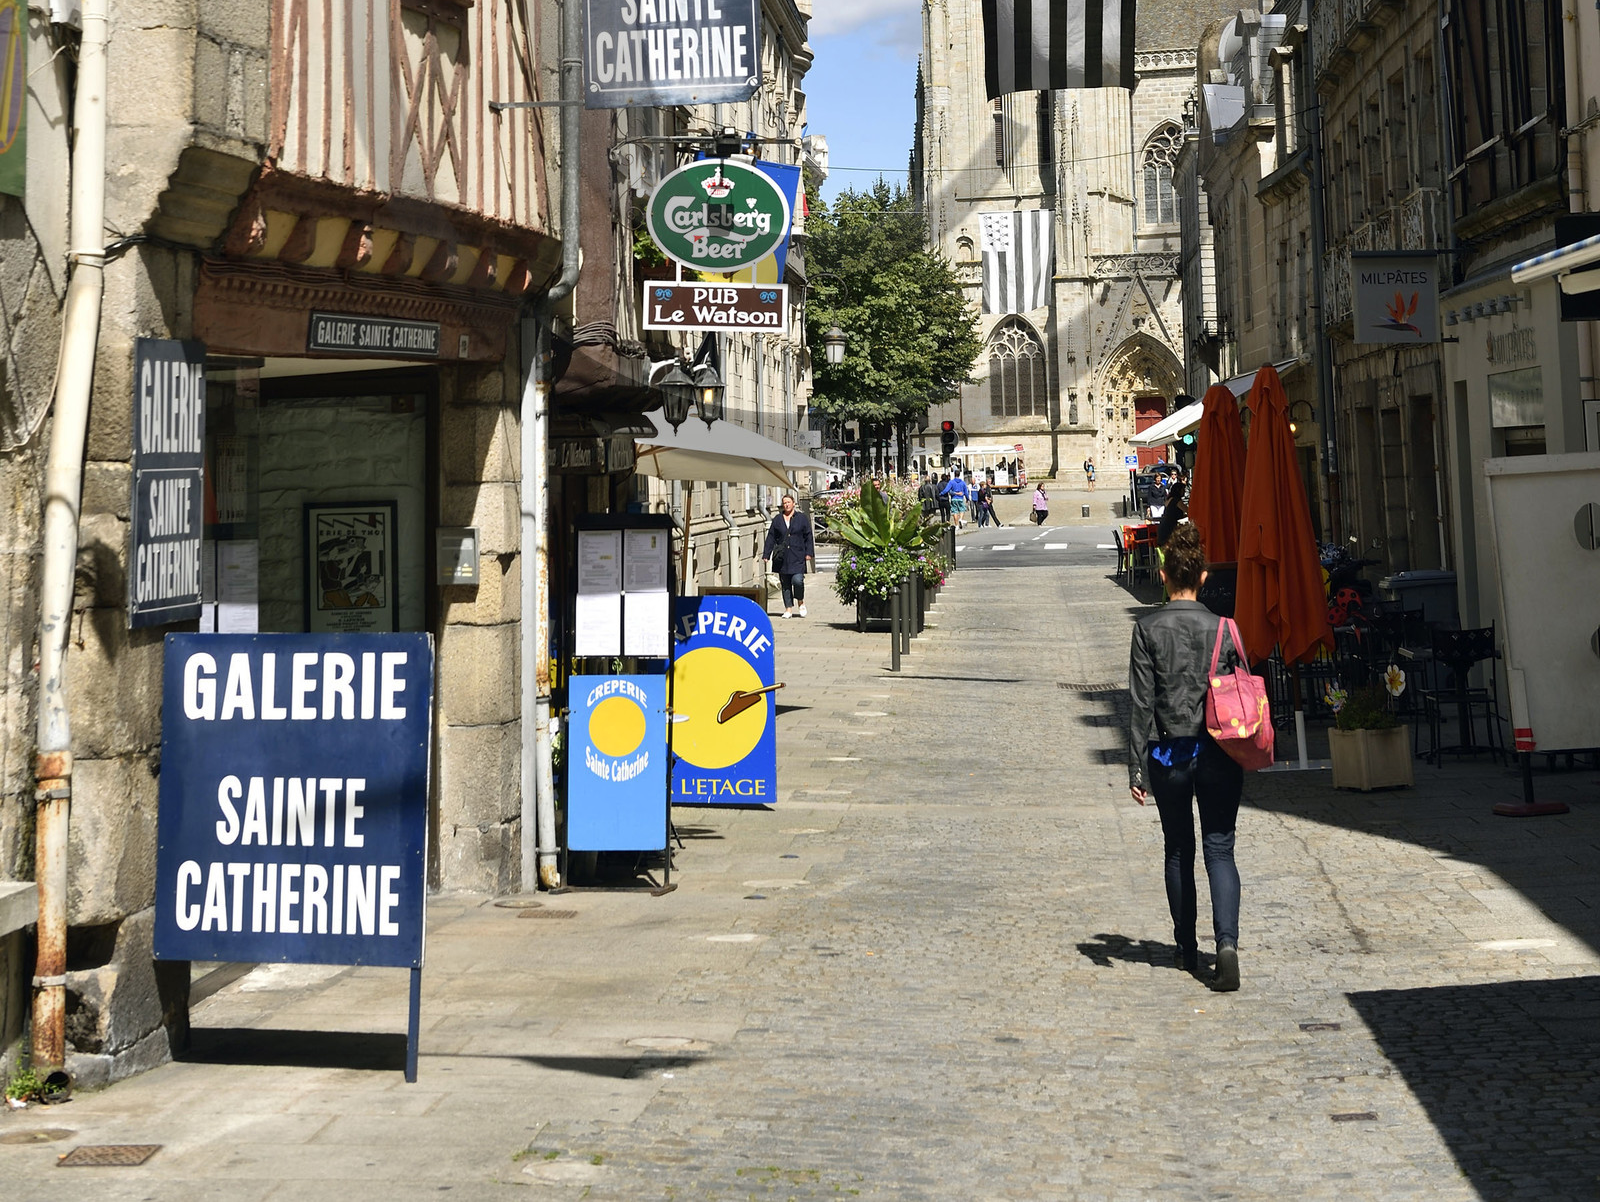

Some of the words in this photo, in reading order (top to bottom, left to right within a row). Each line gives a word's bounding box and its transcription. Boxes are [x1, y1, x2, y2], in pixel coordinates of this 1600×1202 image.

[596, 25, 748, 84] CATHERINE
[663, 195, 772, 234] Carlsberg
[691, 235, 747, 259] Beer
[654, 305, 685, 323] Le
[691, 305, 779, 325] Watson
[693, 288, 739, 304] PUB
[317, 320, 357, 345] GALERIE
[359, 324, 392, 347] SAINTE
[392, 326, 436, 350] CATHERINE
[140, 358, 202, 454] GALERIE
[149, 478, 191, 538] SAINTE
[136, 538, 200, 602] CATHERINE
[183, 651, 408, 721] GALERIE
[586, 679, 648, 709] CREPERIE
[585, 745, 610, 781] Sainte
[611, 750, 649, 782] Catherine
[681, 778, 766, 796] L'ETAGE
[215, 774, 366, 848] SAINTE
[175, 860, 401, 936] CATHERINE
